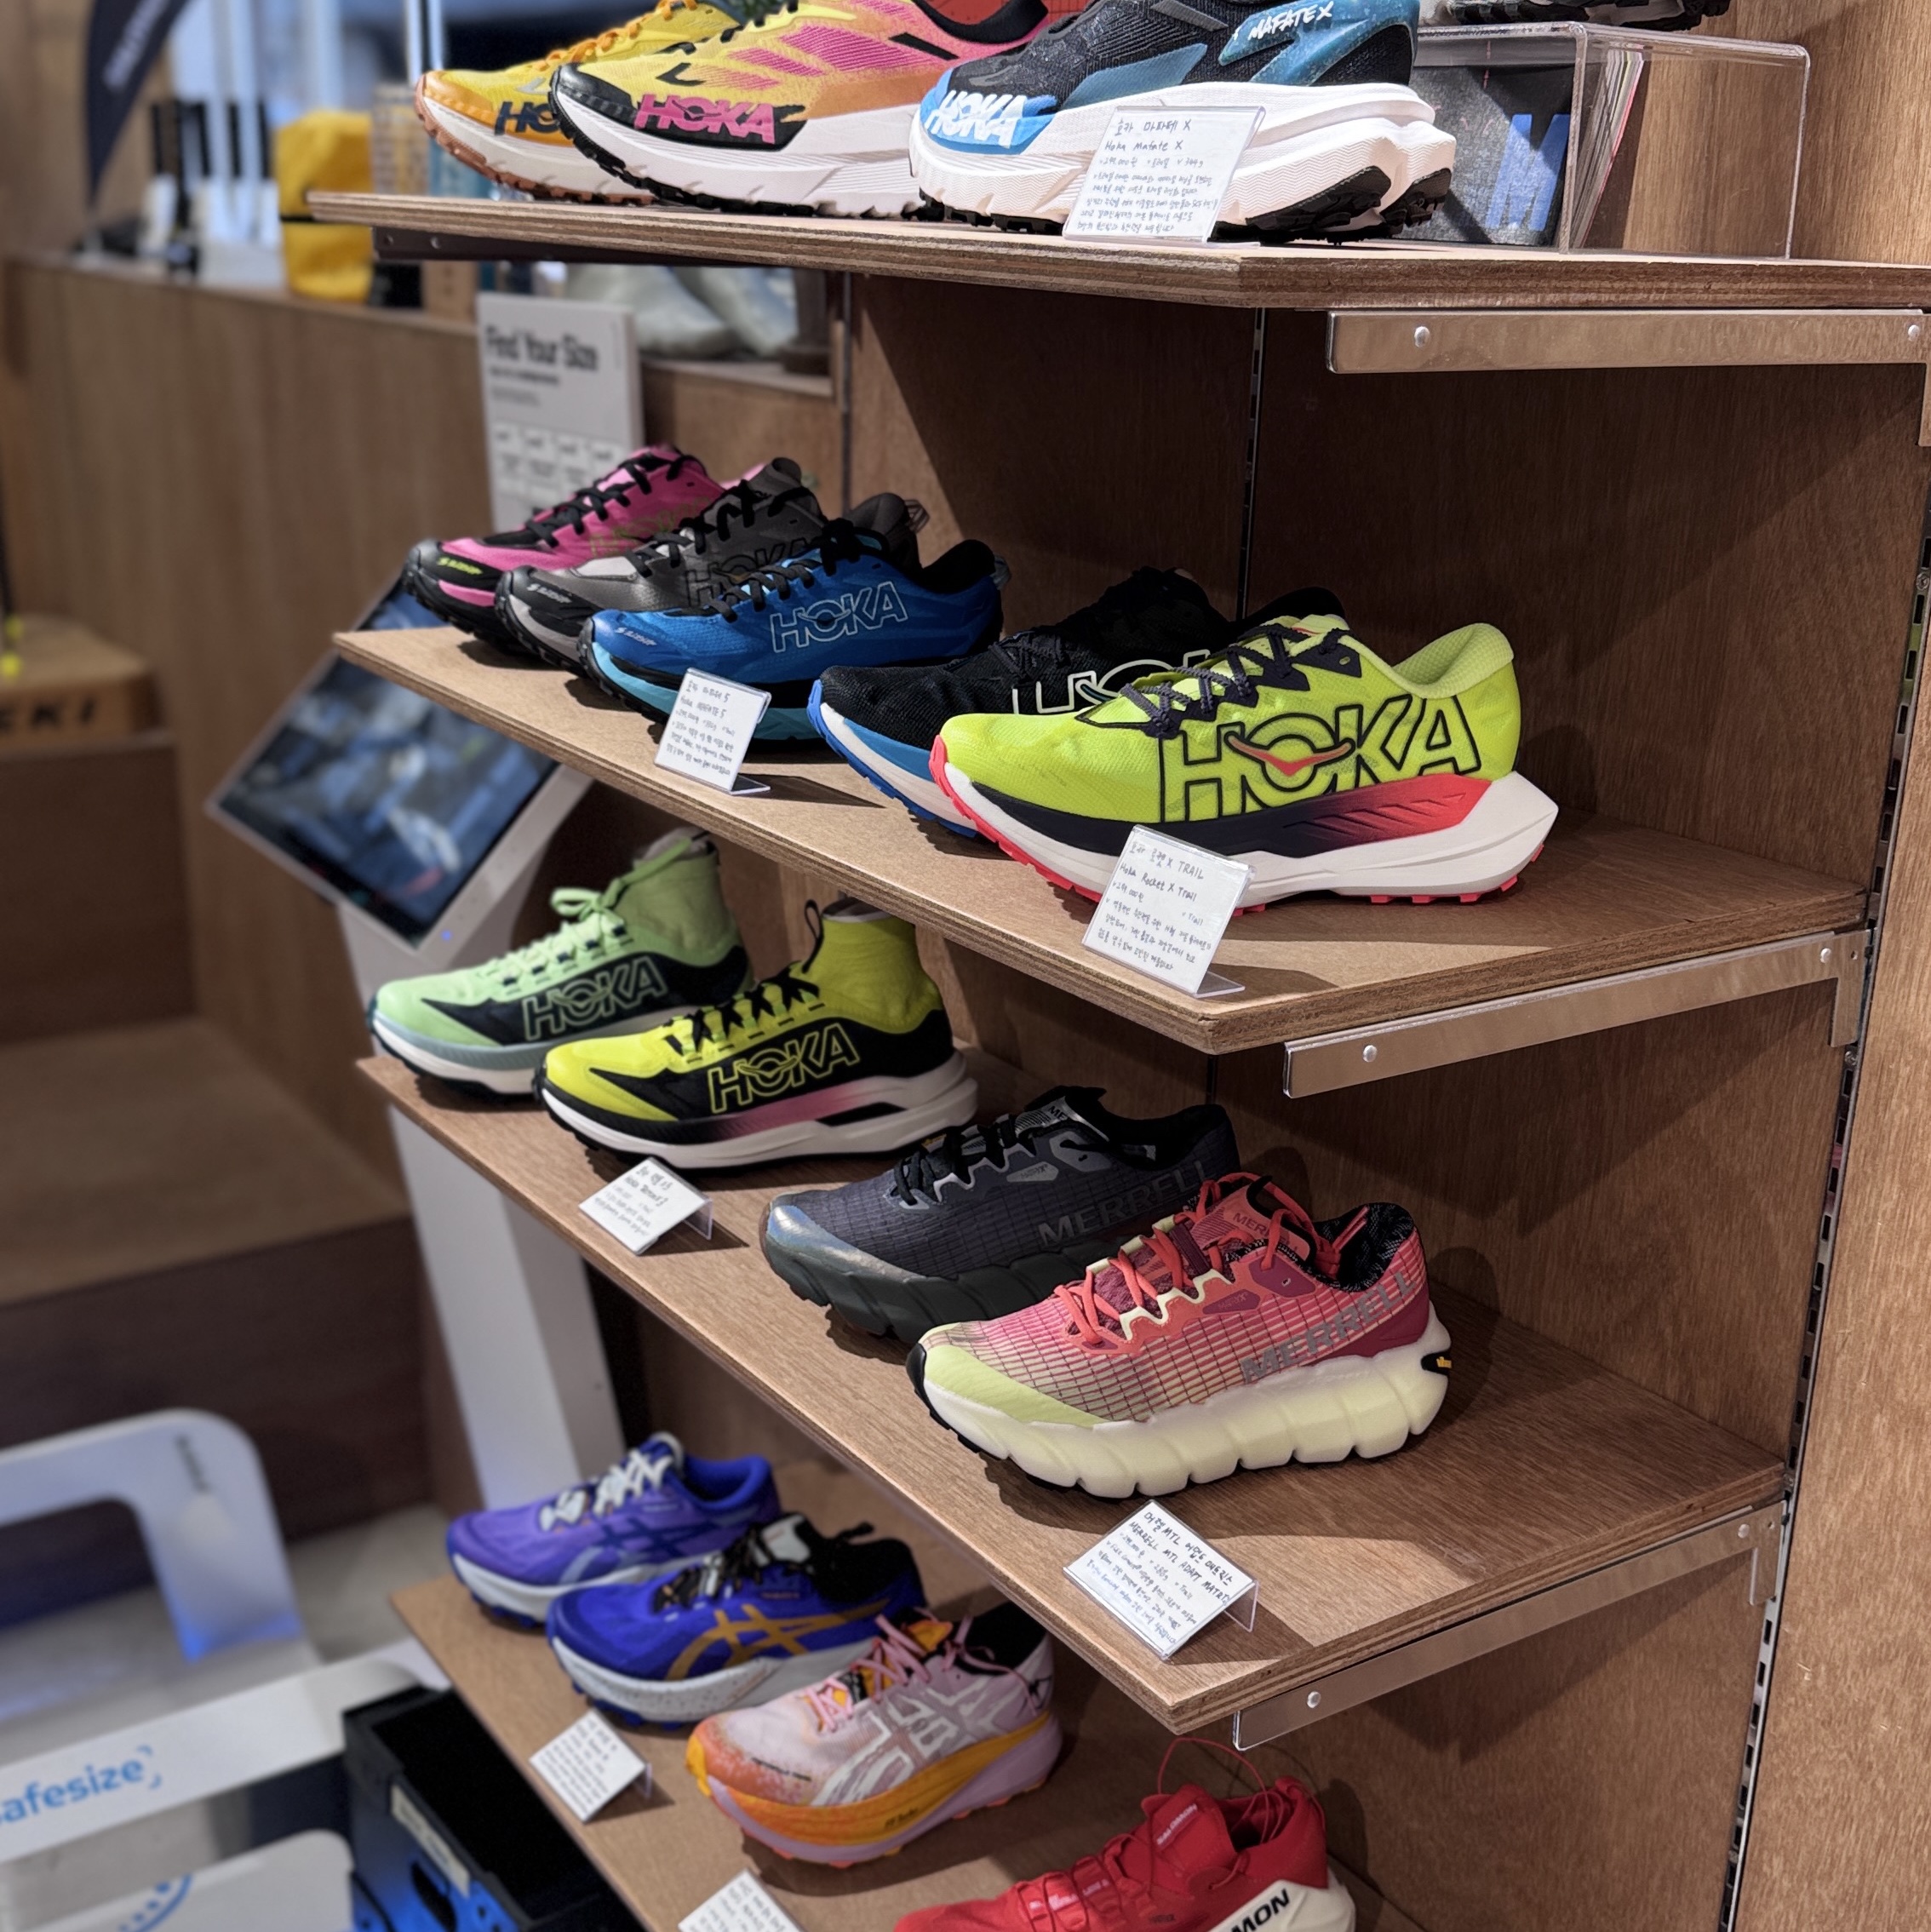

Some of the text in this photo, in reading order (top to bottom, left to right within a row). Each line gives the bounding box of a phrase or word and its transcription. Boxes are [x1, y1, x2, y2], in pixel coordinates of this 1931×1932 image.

[1247, 1, 1334, 41] MAFATE X
[494, 101, 558, 135] HO
[633, 94, 776, 144] HOKA
[924, 89, 1027, 149] HOKA
[1183, 118, 1192, 131] X
[1133, 140, 1168, 152] Mafate
[1175, 140, 1183, 150] X
[770, 581, 908, 653] HOKA
[719, 708, 727, 719] 5
[724, 693, 731, 703] 5
[1160, 693, 1482, 824] HOKA
[1120, 863, 1197, 902] Hoka Rocket X Trail
[1166, 857, 1173, 869] X
[1178, 861, 1204, 880] TRAIL
[522, 955, 668, 1041] HOKA
[707, 1022, 860, 1115] HOKA
[1038, 1160, 1206, 1246] MERRELL
[1240, 1271, 1416, 1383] MERRELL
[1129, 1522, 1158, 1550] MERRELL
[1179, 1562, 1202, 1581] ADAPT
[1161, 1528, 1181, 1545] MTL
[0, 1759, 143, 1823] afesize
